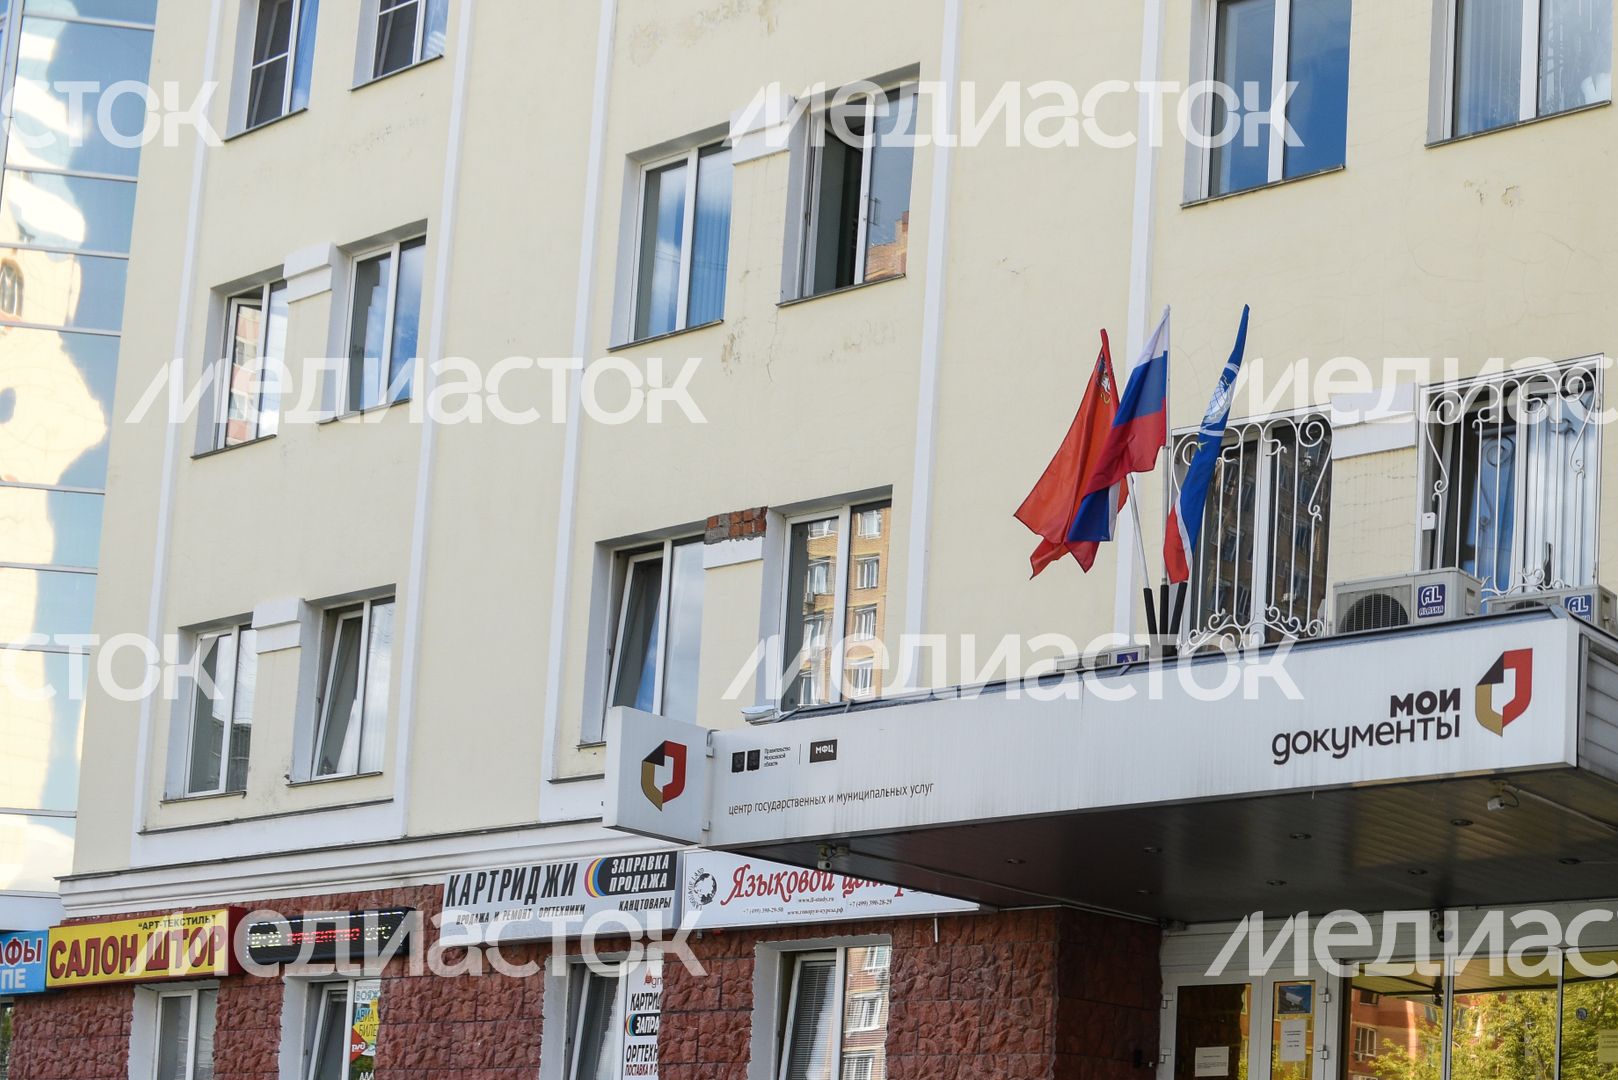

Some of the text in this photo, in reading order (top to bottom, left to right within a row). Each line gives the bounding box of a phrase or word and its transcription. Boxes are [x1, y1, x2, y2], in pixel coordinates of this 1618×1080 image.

[1420, 586, 1442, 604] AL
[1567, 597, 1589, 613] AL
[1419, 604, 1444, 617] ALASKA
[815, 744, 835, 754] МФЦ
[1271, 714, 1461, 765] документы
[728, 782, 935, 816] центр государственных и муниципальных услуг
[611, 854, 669, 874] ЗАПРАВКА
[445, 862, 578, 908] КАРТРИДЖИ
[609, 873, 668, 893] ПРОДАЖА
[720, 864, 835, 905] Языковой
[456, 904, 586, 925] ПРОДАЖА И РЕМОНТ ОРГТЕХНИКИ
[618, 897, 672, 912] КАНЦТОВАРЫ
[49, 925, 228, 979] САЛОН ШТОР
[630, 993, 660, 1011] КАРТРИ
